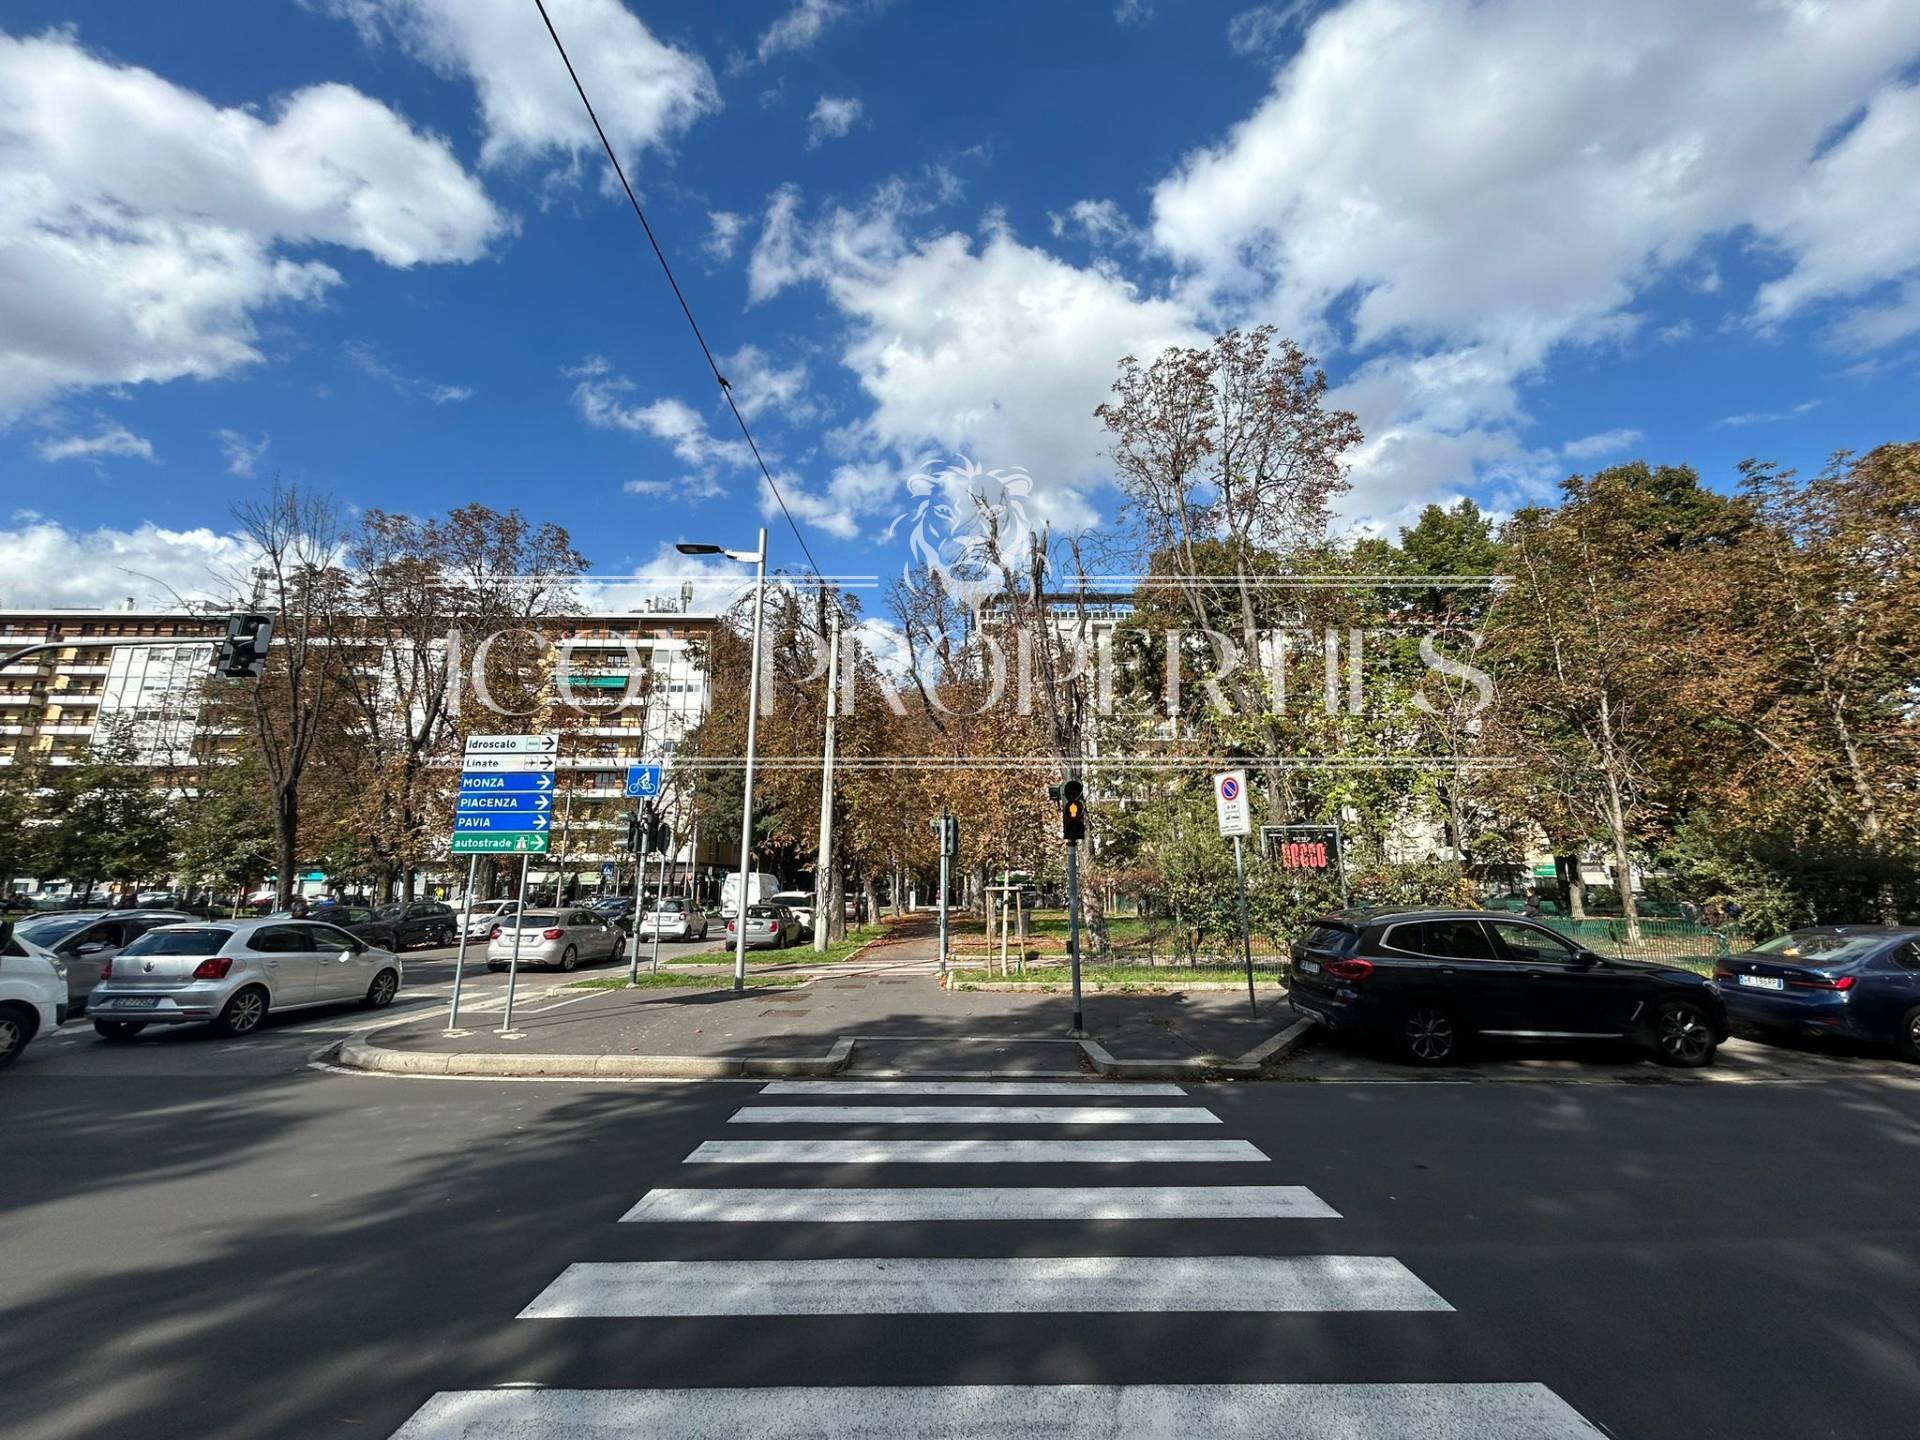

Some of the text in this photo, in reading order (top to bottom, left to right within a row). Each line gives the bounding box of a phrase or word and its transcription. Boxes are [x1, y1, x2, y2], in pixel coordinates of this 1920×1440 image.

[469, 740, 517, 749] Idroscalo
[466, 759, 499, 767] Linate
[463, 778, 505, 788] MONZA
[460, 798, 518, 808] PIACENZA
[458, 817, 491, 827] PAVIA
[454, 838, 513, 848] autostrade
